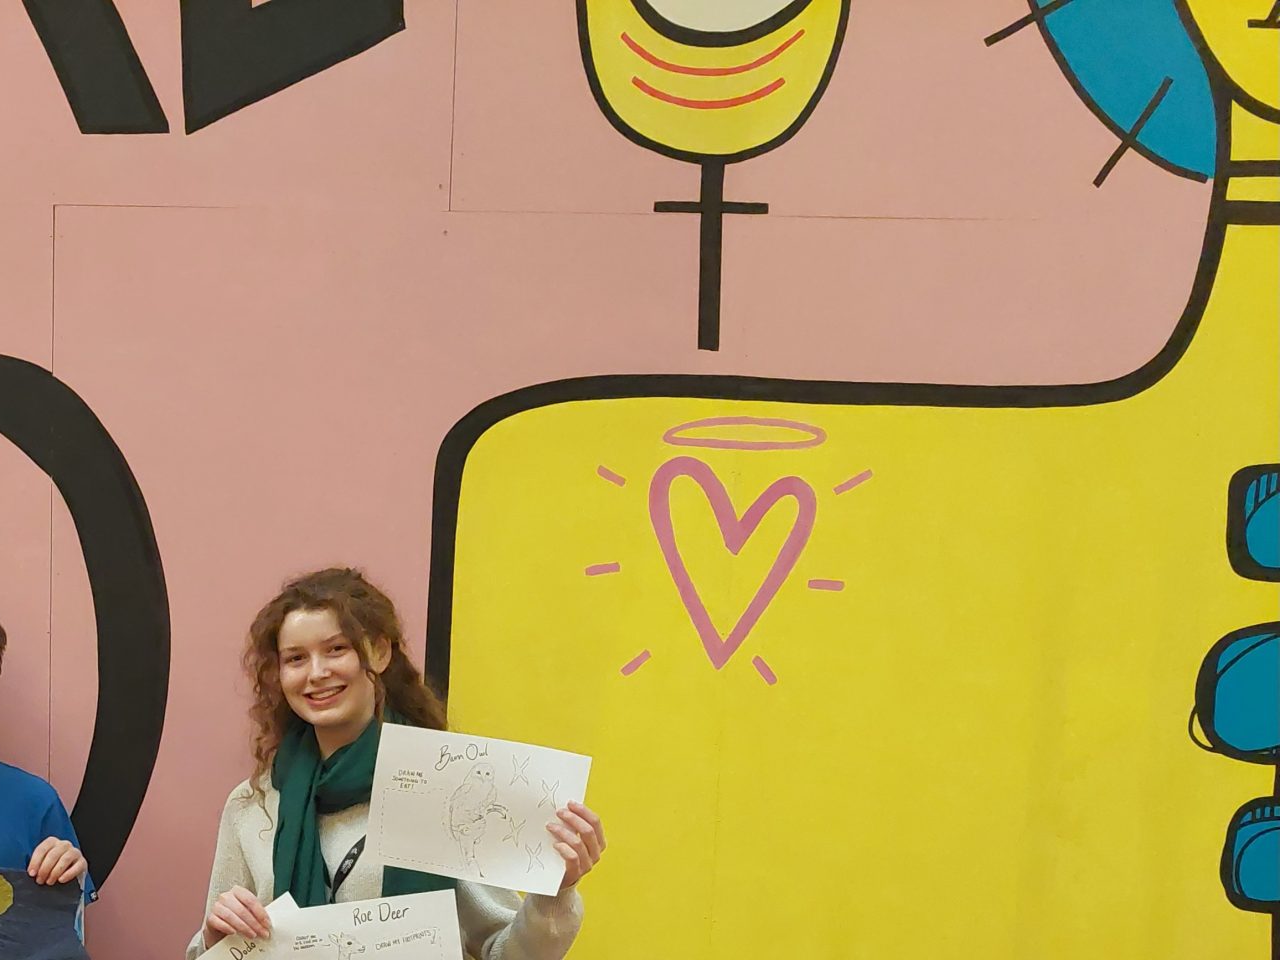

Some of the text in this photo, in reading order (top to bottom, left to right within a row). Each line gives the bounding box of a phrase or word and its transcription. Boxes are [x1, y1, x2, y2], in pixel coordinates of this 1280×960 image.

[465, 742, 489, 761] Owl
[352, 902, 410, 926] Roe Deer
